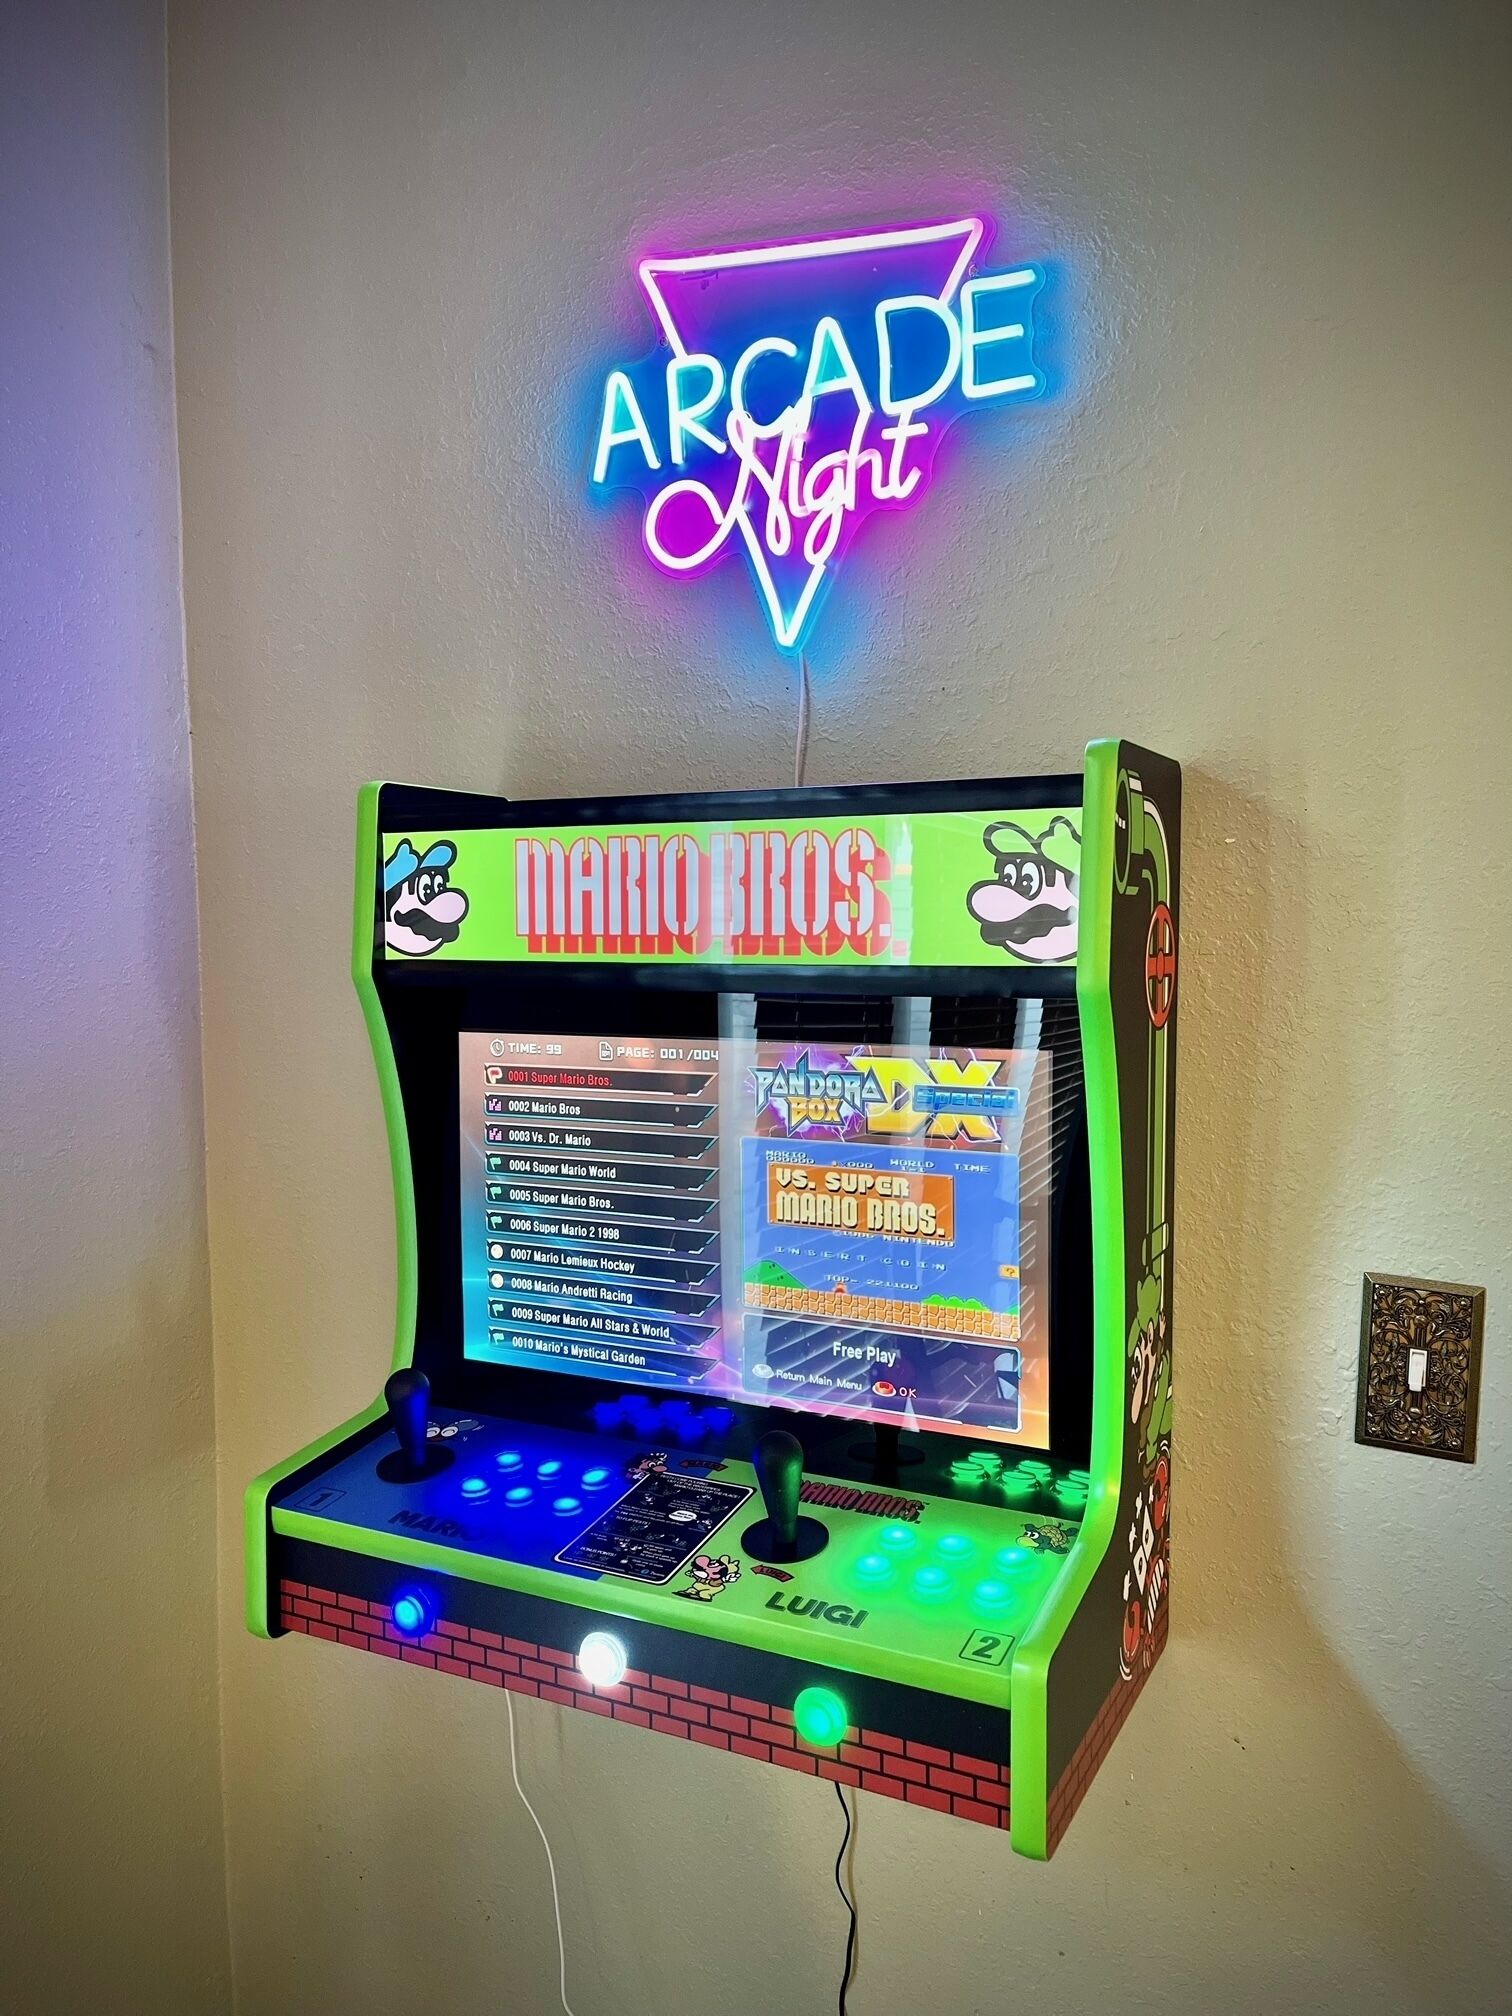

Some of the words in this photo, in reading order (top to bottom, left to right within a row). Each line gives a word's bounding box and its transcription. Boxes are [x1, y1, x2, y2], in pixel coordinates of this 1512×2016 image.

[592, 268, 1037, 483] ARCADE
[645, 406, 929, 568] Night
[515, 834, 708, 952] MARIO
[709, 828, 904, 952] BROS.
[508, 1042, 541, 1055] TIME:
[545, 1044, 562, 1055] 99
[617, 1046, 655, 1058] PAGE:
[508, 1070, 529, 1082] 0001
[531, 1071, 557, 1085] Super
[559, 1073, 585, 1085] Mario
[588, 1074, 613, 1087] Bros.
[750, 1048, 886, 1117] PANDORA
[508, 1100, 530, 1112] 0002
[532, 1101, 557, 1114] Mario
[559, 1102, 580, 1115] Bros
[915, 1087, 1016, 1111] Special
[786, 1097, 846, 1135] BOX
[508, 1129, 531, 1142] 0003
[532, 1131, 547, 1143] Vs.
[549, 1131, 564, 1145] Dr.
[565, 1133, 591, 1146] Mario
[766, 1149, 807, 1159] MARIO
[890, 1158, 935, 1169] WORLD
[953, 1163, 992, 1174] TIME
[509, 1159, 531, 1172] 0004
[532, 1160, 559, 1175] Super
[561, 1163, 587, 1176] Mario
[589, 1164, 616, 1179] World
[776, 1168, 816, 1190] VS.
[825, 1172, 911, 1198] SUPER
[509, 1188, 531, 1201] 0005
[532, 1190, 559, 1205] Super
[561, 1192, 587, 1206] Mario
[589, 1194, 615, 1209] Bros.
[776, 1191, 859, 1229] MARIO
[867, 1198, 946, 1237] BROS.
[510, 1218, 532, 1231] 0006
[533, 1220, 559, 1235] Super
[561, 1222, 588, 1237] Mario
[589, 1225, 596, 1237] 2
[598, 1226, 620, 1240] 1998
[882, 1234, 955, 1248] NINTENDO
[510, 1248, 532, 1261] 0007
[533, 1250, 559, 1264] Mario
[561, 1253, 599, 1268] Lemieux
[600, 1257, 636, 1274] Hockey
[511, 1277, 533, 1290] 0008
[534, 1279, 560, 1293] Mario
[561, 1283, 598, 1298] Andretti
[599, 1287, 633, 1304] Racing
[511, 1307, 533, 1320] 0009
[534, 1309, 561, 1325] Super
[562, 1313, 589, 1328] Mario
[590, 1317, 603, 1329] All
[605, 1319, 630, 1333] Stars
[632, 1323, 639, 1334] &
[641, 1324, 670, 1338] World
[512, 1336, 534, 1349] 0010
[535, 1339, 569, 1354] Mario's
[571, 1344, 609, 1361] Mystical
[611, 1351, 646, 1366] Garden
[833, 1342, 863, 1360] Free
[866, 1346, 897, 1368] Play
[776, 1369, 806, 1383] Return
[809, 1373, 833, 1386] Main
[836, 1378, 862, 1391] Menu
[899, 1387, 917, 1398] OK
[309, 1492, 334, 1507] 1
[759, 1566, 788, 1580] LUIGI
[765, 1591, 870, 1629] LUIGI
[979, 1635, 1002, 1660] 2
